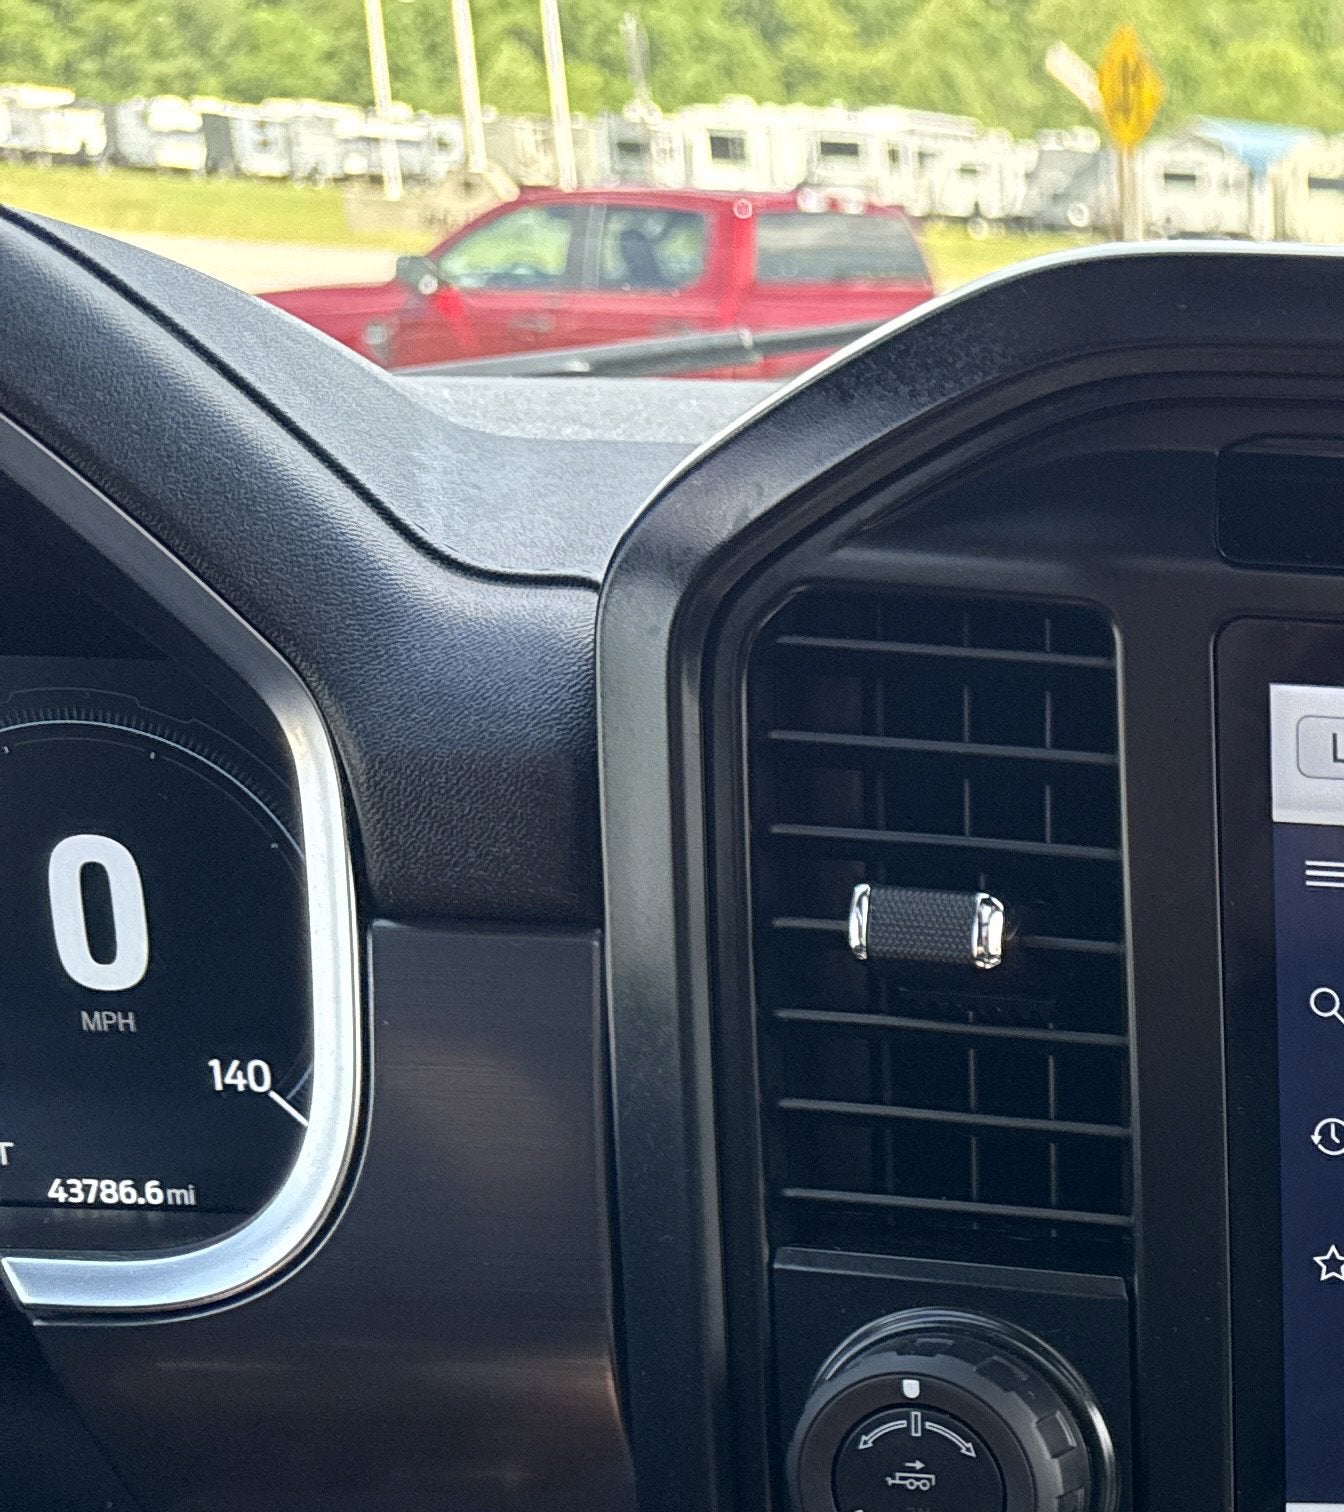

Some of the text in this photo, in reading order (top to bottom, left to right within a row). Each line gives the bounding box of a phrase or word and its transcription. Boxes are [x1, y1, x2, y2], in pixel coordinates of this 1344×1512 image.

[48, 834, 150, 992] 0
[81, 1010, 137, 1033] MPH
[207, 1059, 272, 1093] 140
[47, 1178, 197, 1206] 43786.6 mi
